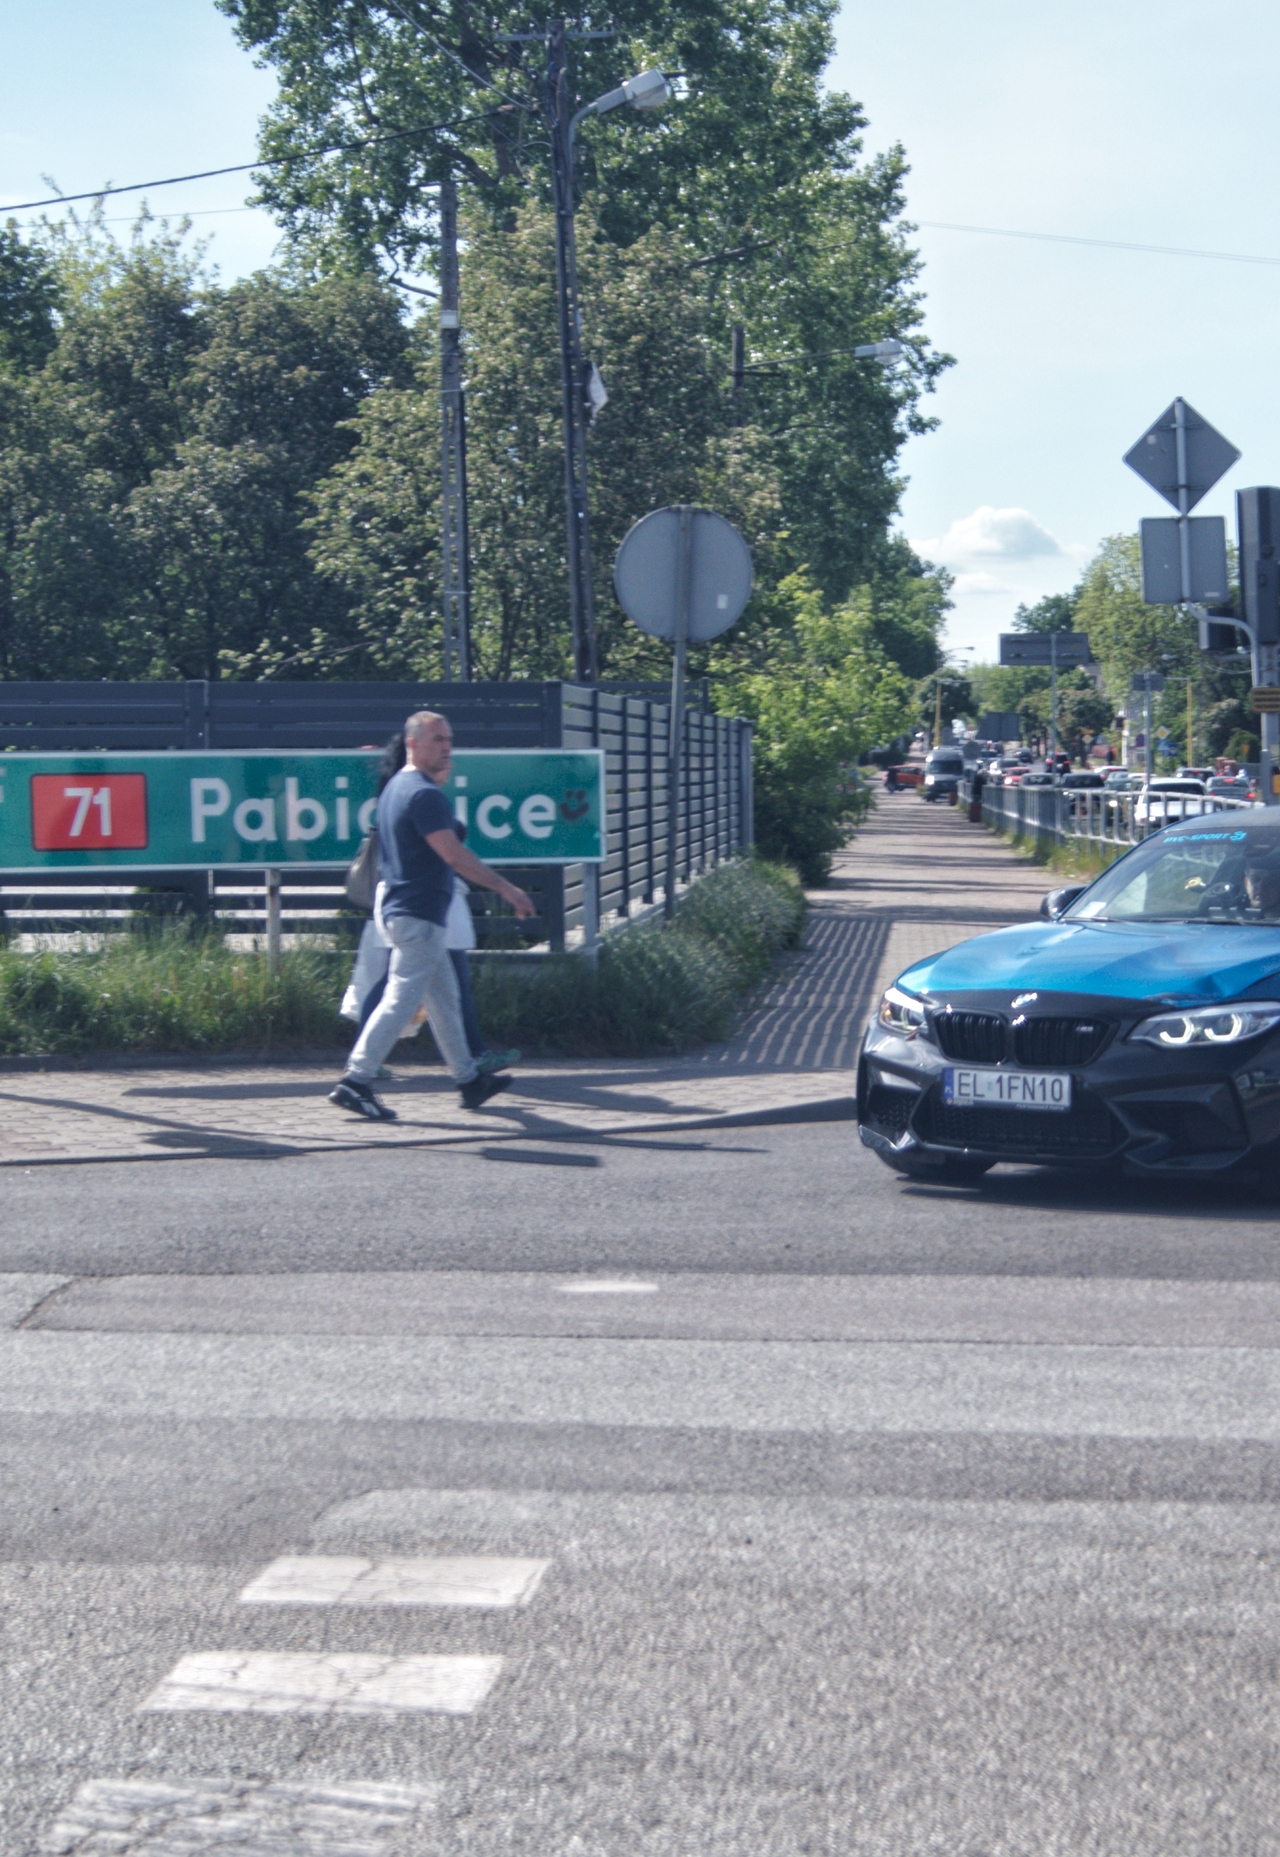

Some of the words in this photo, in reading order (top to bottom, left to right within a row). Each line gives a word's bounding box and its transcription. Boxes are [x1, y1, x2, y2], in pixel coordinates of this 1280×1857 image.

[63, 786, 112, 837] 71
[190, 775, 557, 842] Pabiice
[957, 1072, 985, 1098] EL
[995, 1074, 1064, 1103] 1FN10
